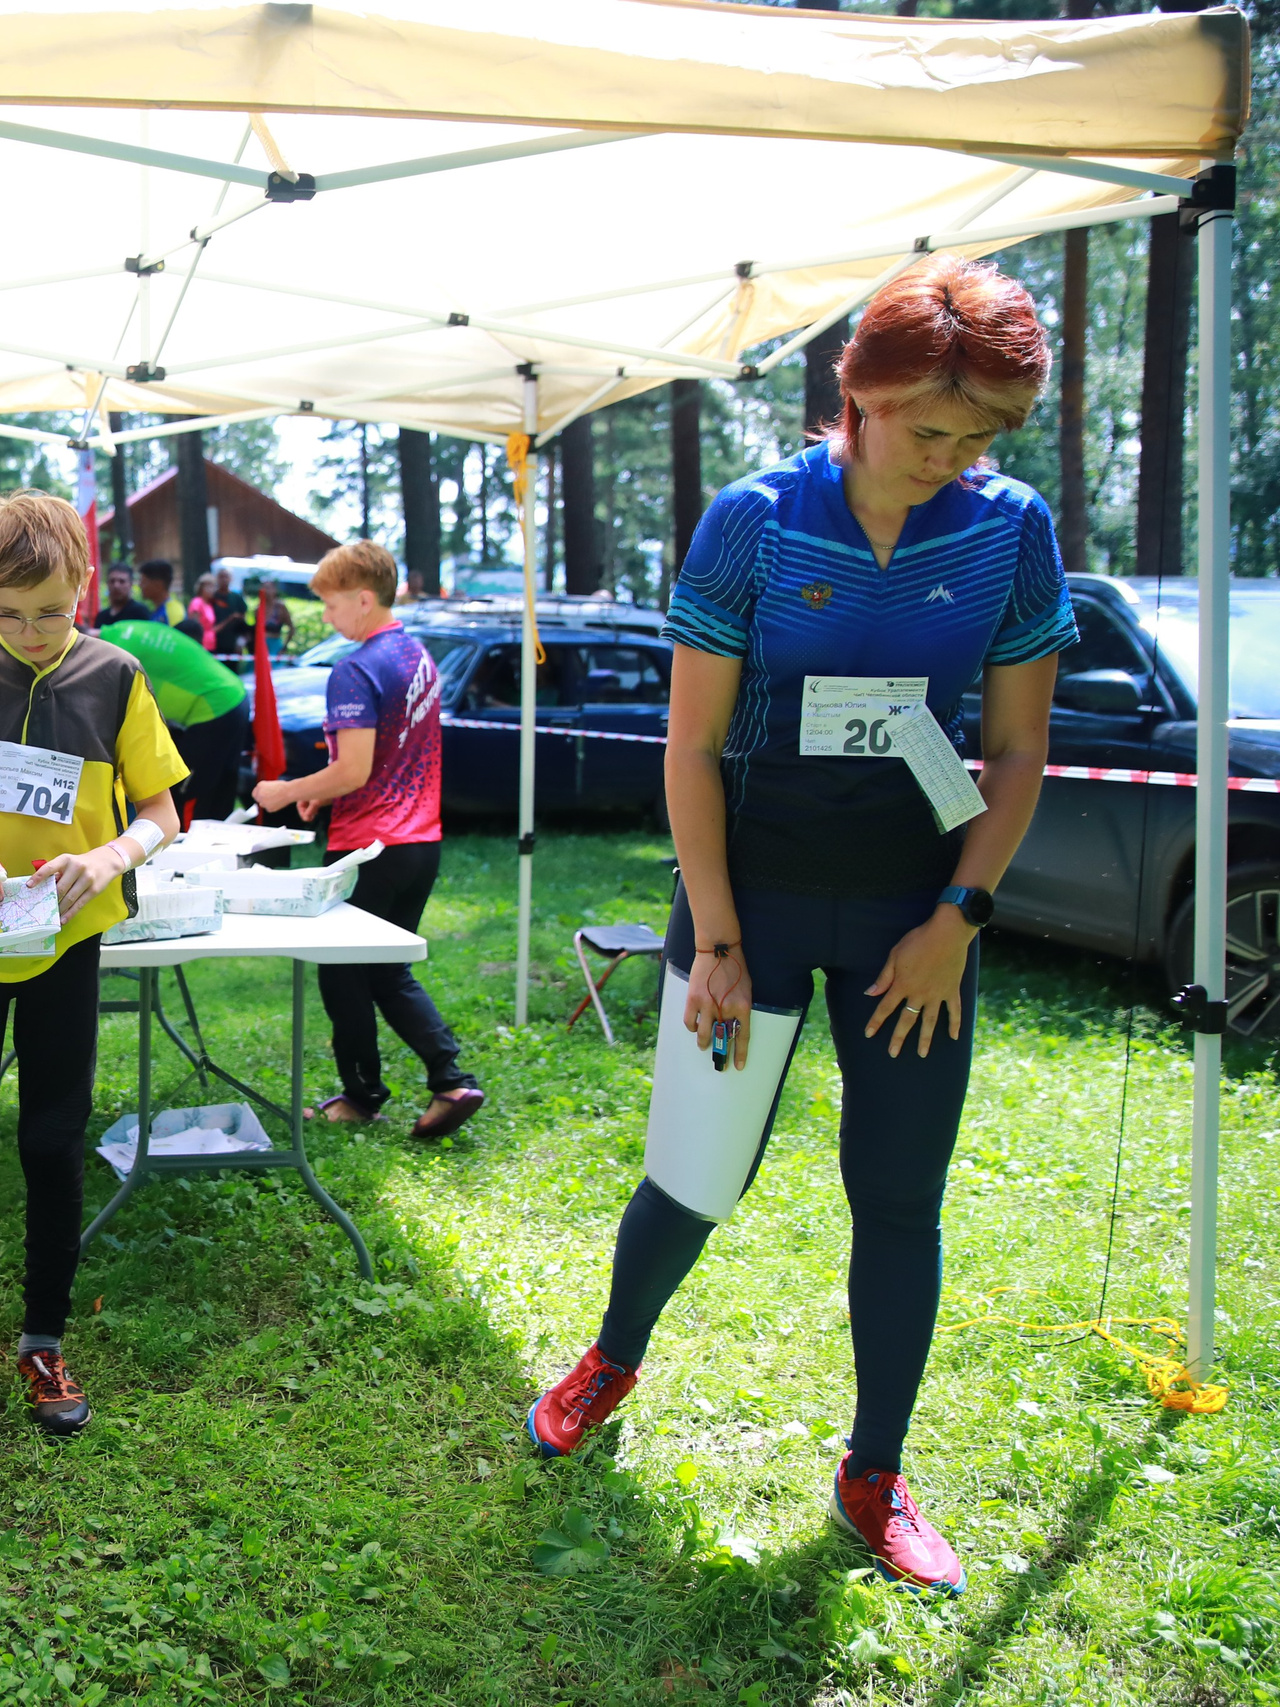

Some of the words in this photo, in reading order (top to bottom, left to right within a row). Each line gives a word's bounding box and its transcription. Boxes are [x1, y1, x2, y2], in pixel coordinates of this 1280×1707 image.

[19, 767, 43, 777] Максим
[53, 777, 75, 790] М12
[16, 782, 70, 821] 704
